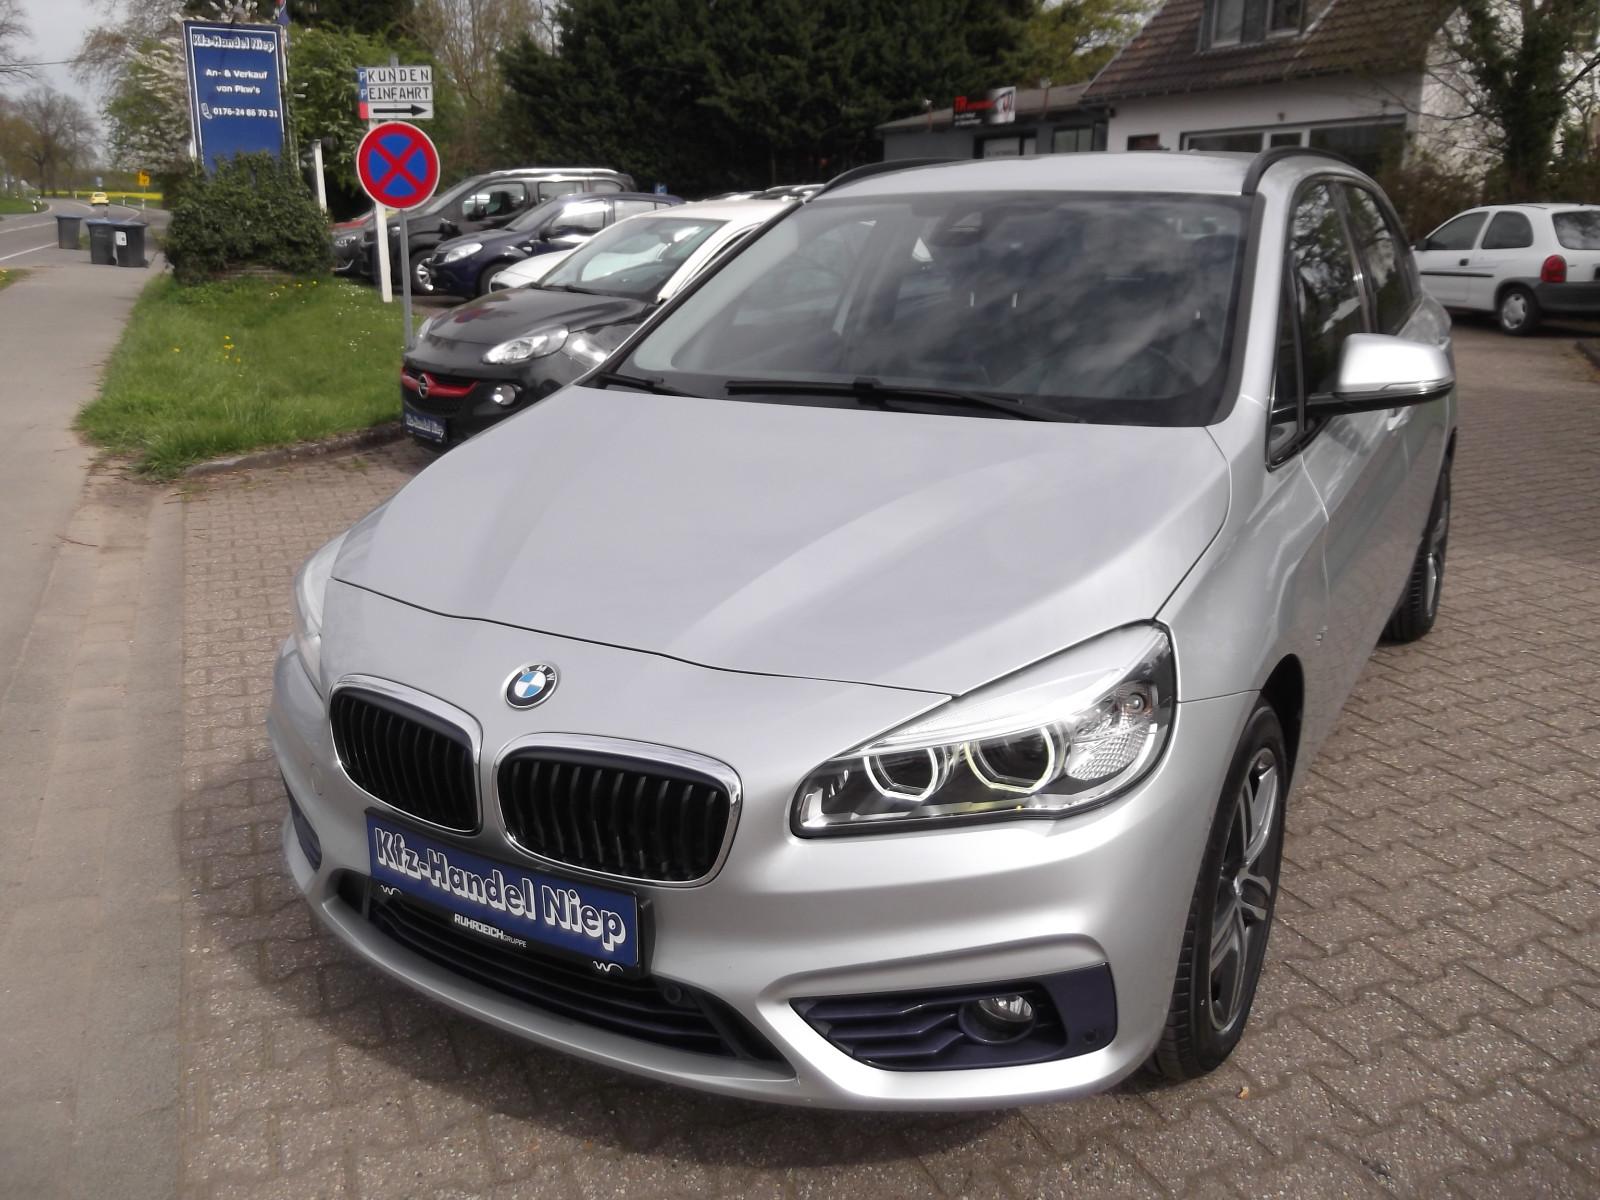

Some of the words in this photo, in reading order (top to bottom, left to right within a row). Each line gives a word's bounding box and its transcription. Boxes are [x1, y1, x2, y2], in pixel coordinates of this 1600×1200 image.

[206, 69, 221, 77] An-
[224, 69, 231, 78] &
[233, 70, 267, 80] Verkauf
[368, 69, 429, 82] KUNDEN
[369, 87, 429, 100] EINFAHRT
[375, 828, 536, 921] Kfz-Handel
[542, 885, 626, 951] Niep
